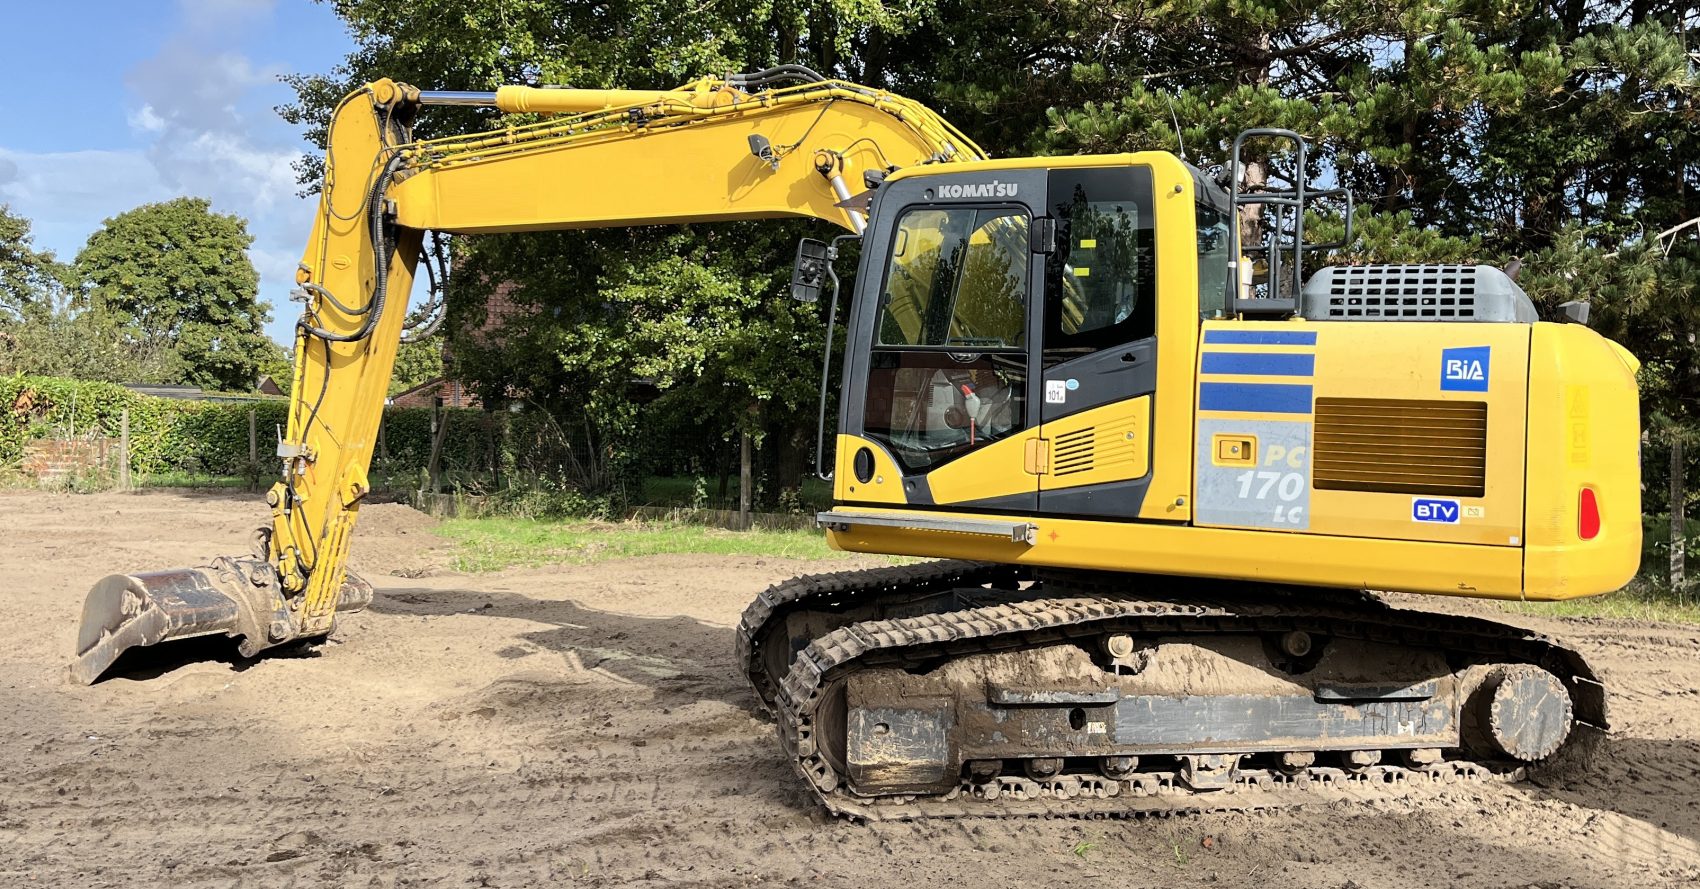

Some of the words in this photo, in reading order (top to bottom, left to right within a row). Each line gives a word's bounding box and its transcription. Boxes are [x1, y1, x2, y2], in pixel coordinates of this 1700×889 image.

[938, 180, 1018, 198] KOMATSU
[1048, 390, 1060, 401] 101
[1264, 444, 1306, 468] PC
[1236, 470, 1305, 502] 170
[1272, 504, 1303, 524] LC
